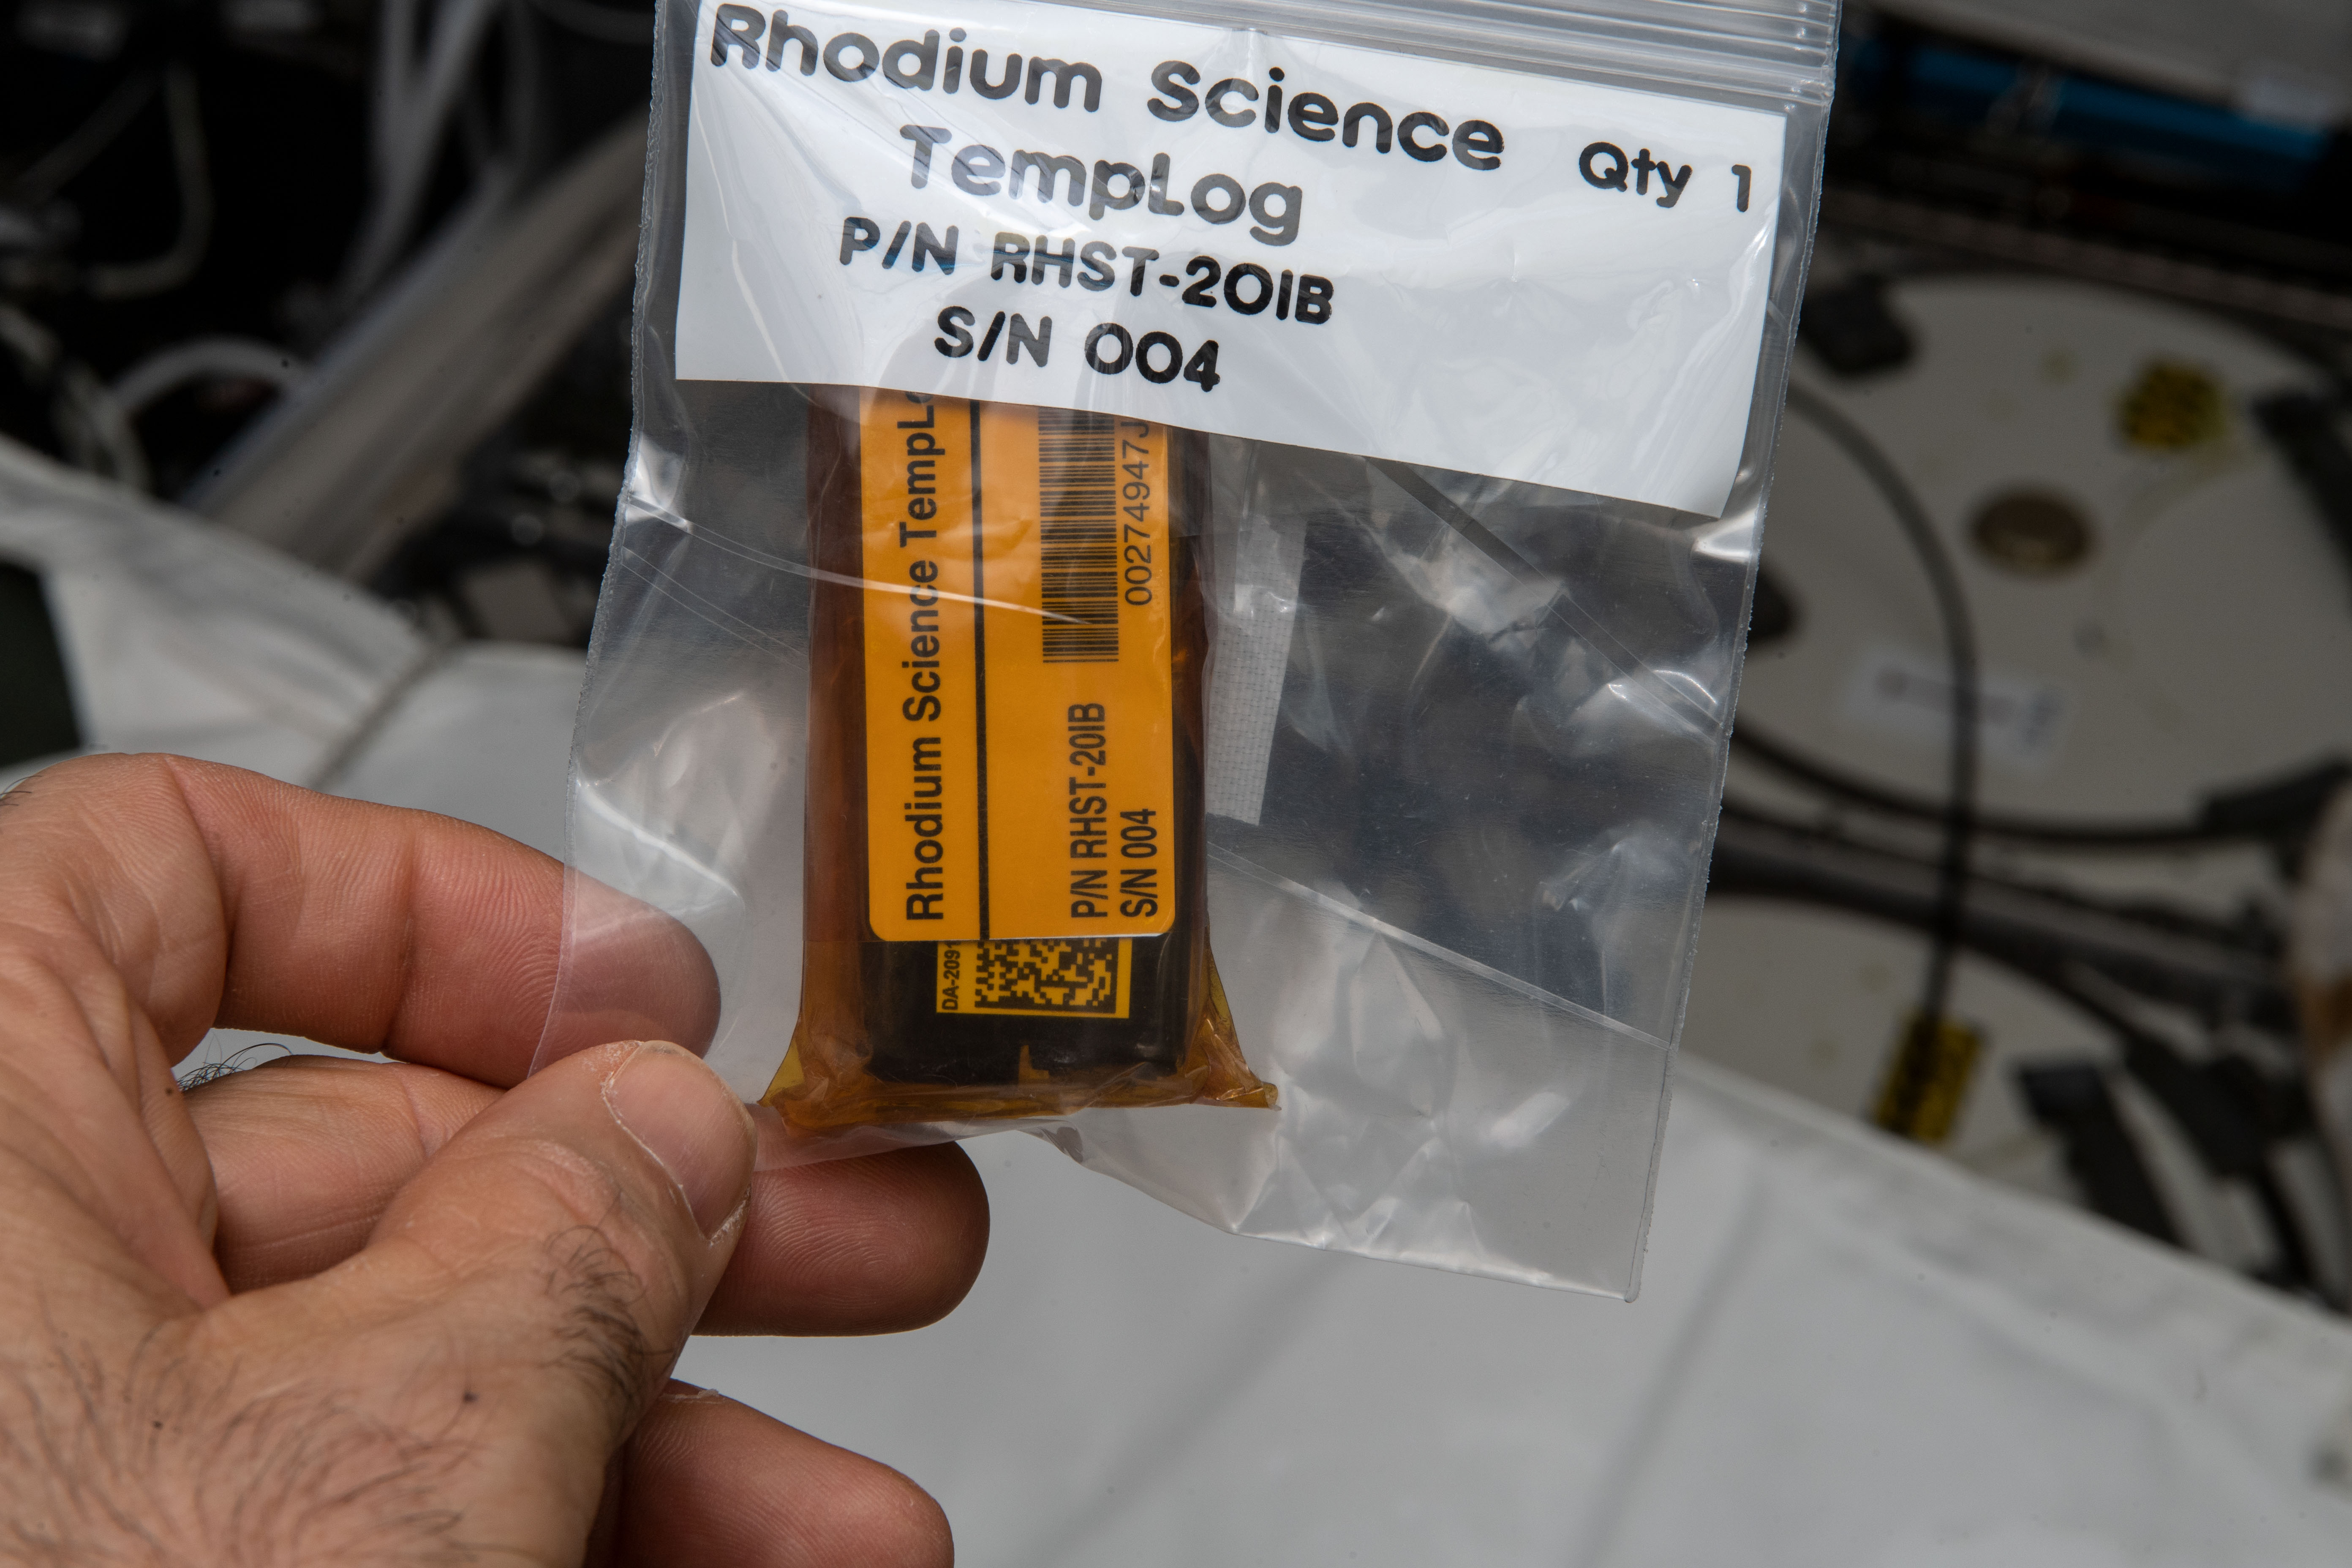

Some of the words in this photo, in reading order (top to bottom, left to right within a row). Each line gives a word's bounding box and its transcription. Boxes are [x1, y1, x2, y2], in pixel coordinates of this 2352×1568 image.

[711, 4, 1102, 112] Rhodium
[1147, 60, 1504, 170] Science
[900, 125, 1302, 246] TempLog
[1579, 142, 1692, 208] Qty
[1731, 164, 1751, 212] 1
[839, 217, 959, 275] P/N
[934, 306, 1052, 367] S/N
[1085, 323, 1220, 392] 004
[1120, 422, 1152, 606] 00274947J
[902, 560, 941, 721] Science
[904, 737, 944, 920] Rhodium
[1120, 808, 1157, 858] 004
[1070, 870, 1108, 917] P/N
[1120, 869, 1157, 917] S/N
